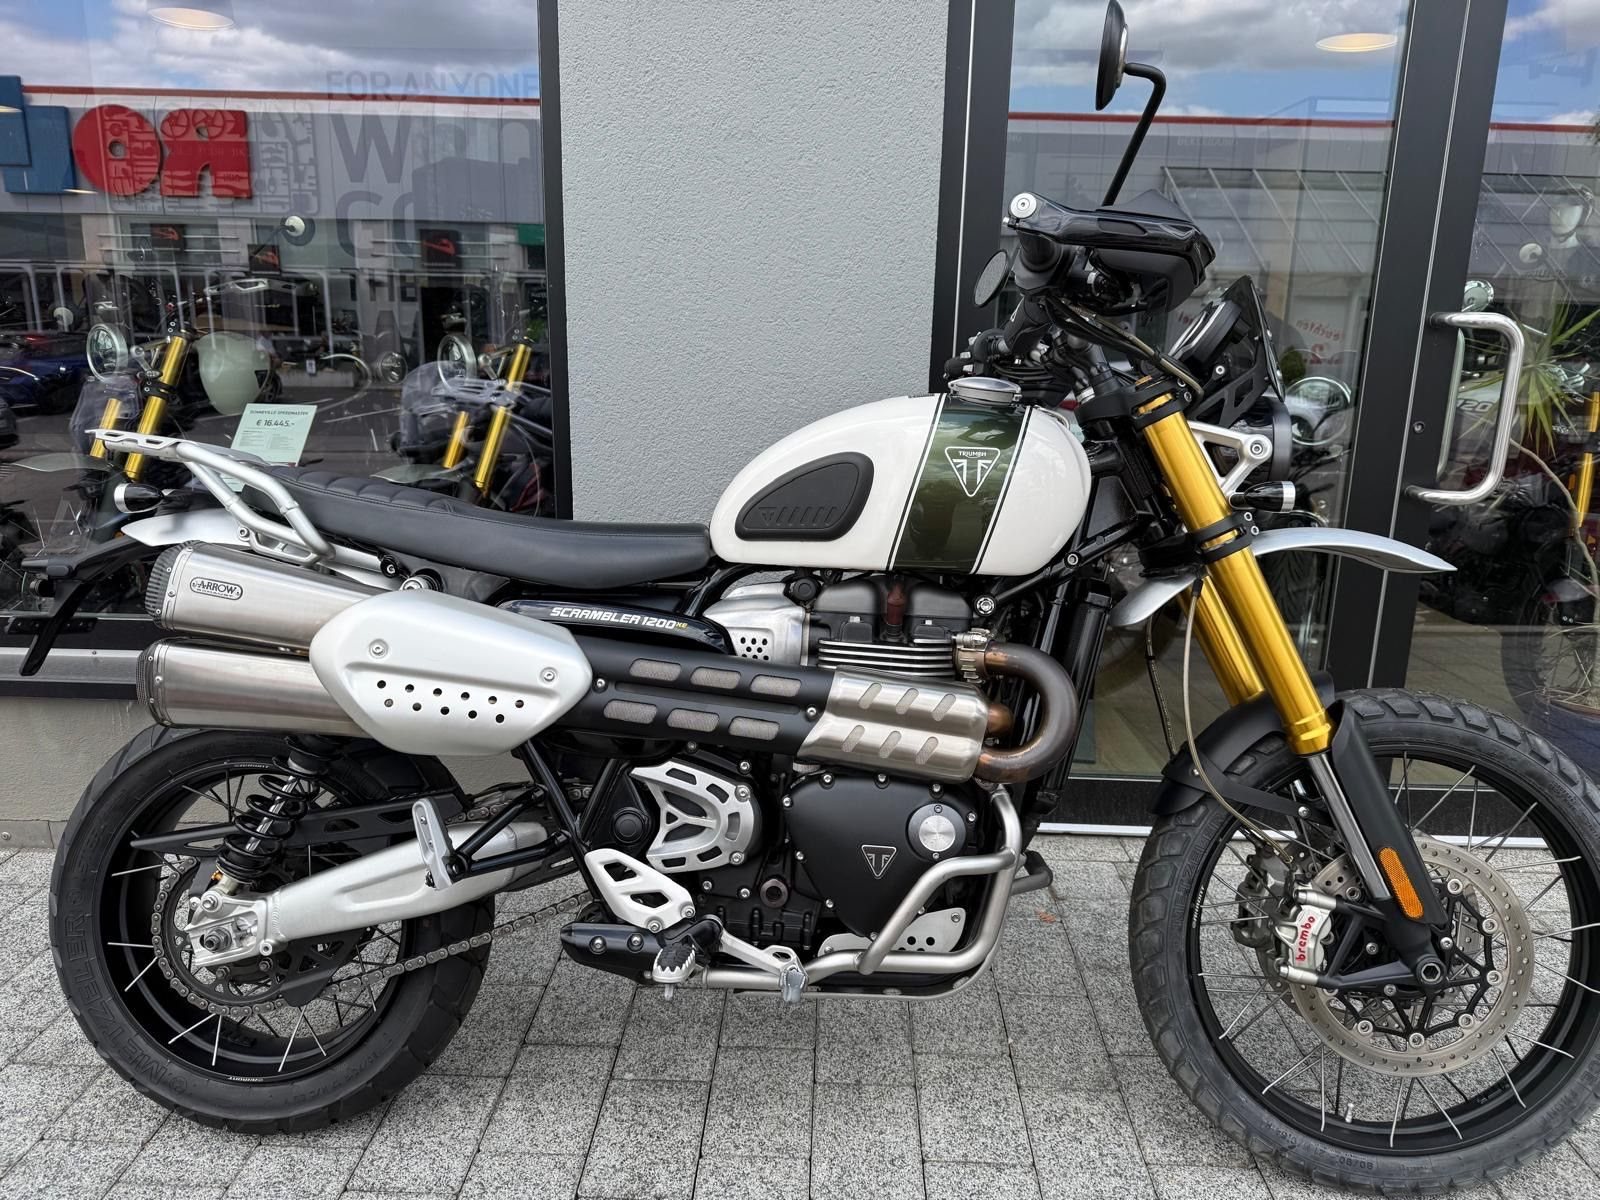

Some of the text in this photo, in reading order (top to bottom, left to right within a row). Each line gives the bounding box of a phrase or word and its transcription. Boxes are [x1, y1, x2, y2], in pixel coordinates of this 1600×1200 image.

[326, 71, 392, 101] FOR
[958, 450, 987, 458] TRIUMPH
[197, 580, 237, 595] ARROW
[550, 607, 640, 625] SCRAMBLER
[1295, 915, 1316, 961] brembo
[63, 912, 168, 1086] METZELER
